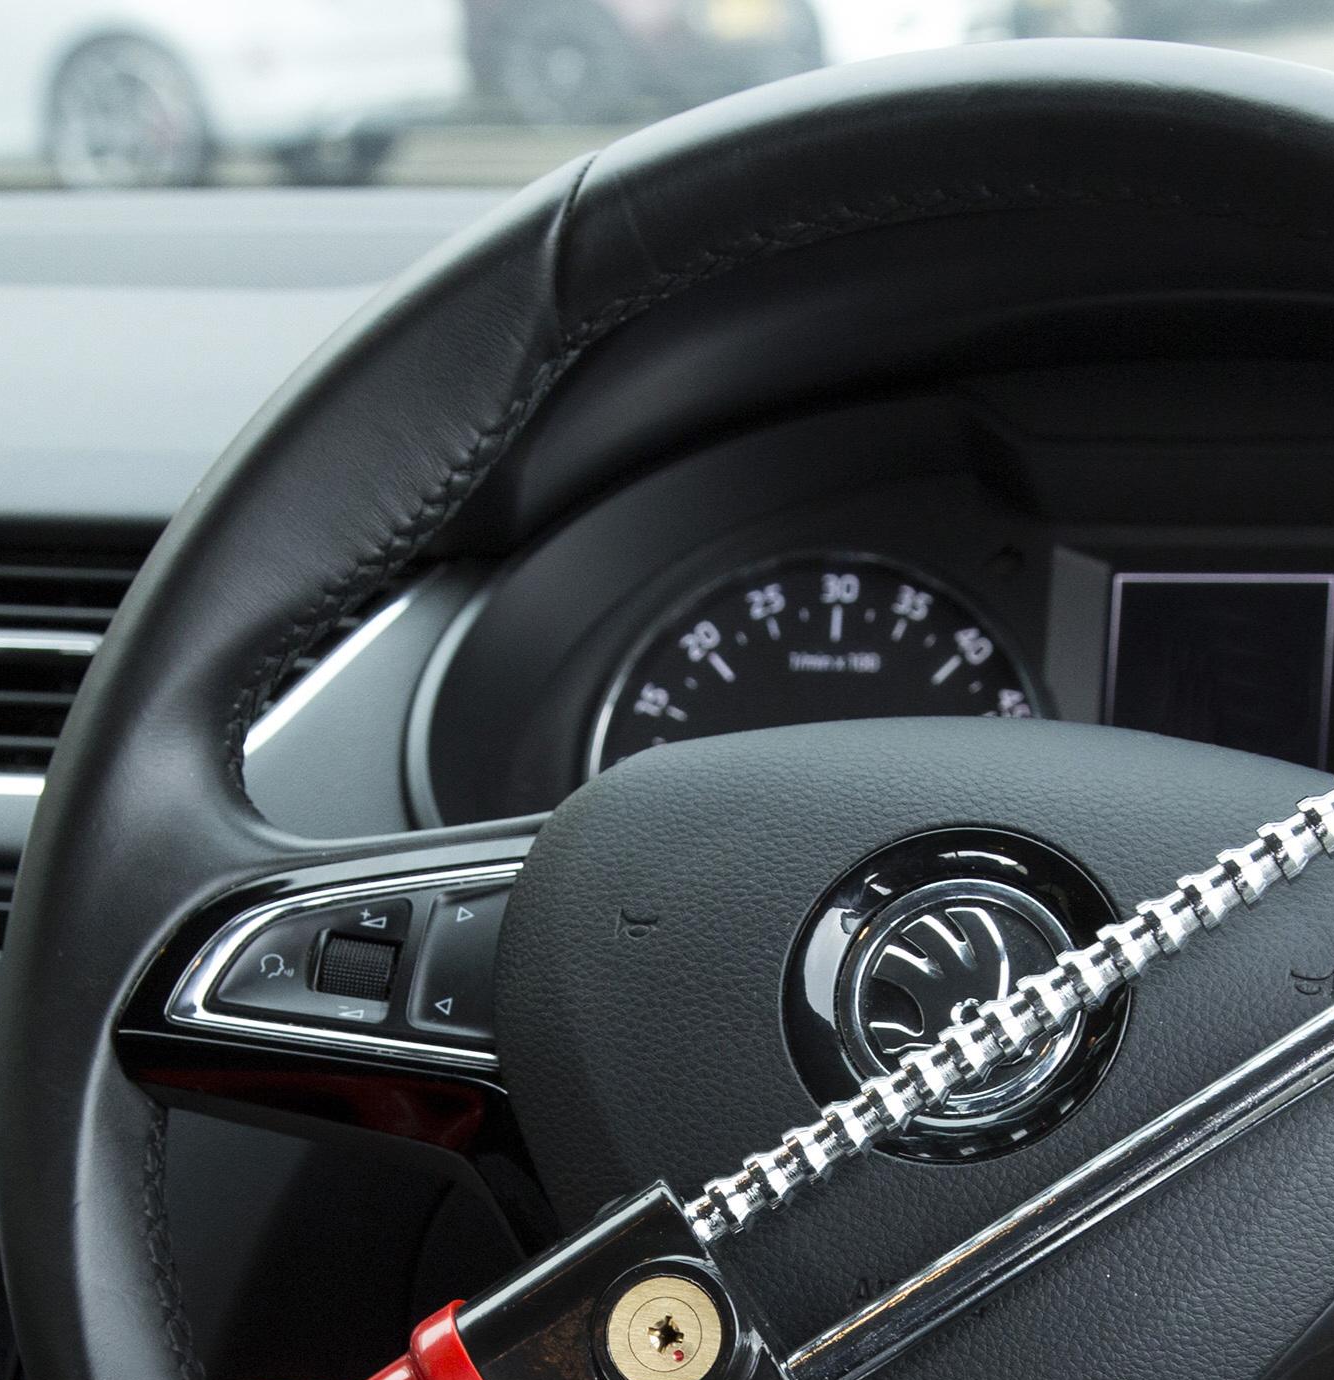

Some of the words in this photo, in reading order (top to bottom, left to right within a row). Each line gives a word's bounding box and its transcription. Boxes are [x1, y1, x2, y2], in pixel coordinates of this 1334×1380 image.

[746, 583, 786, 620] 25
[820, 573, 860, 604] 30
[891, 585, 933, 621] 35
[679, 619, 721, 662] 20
